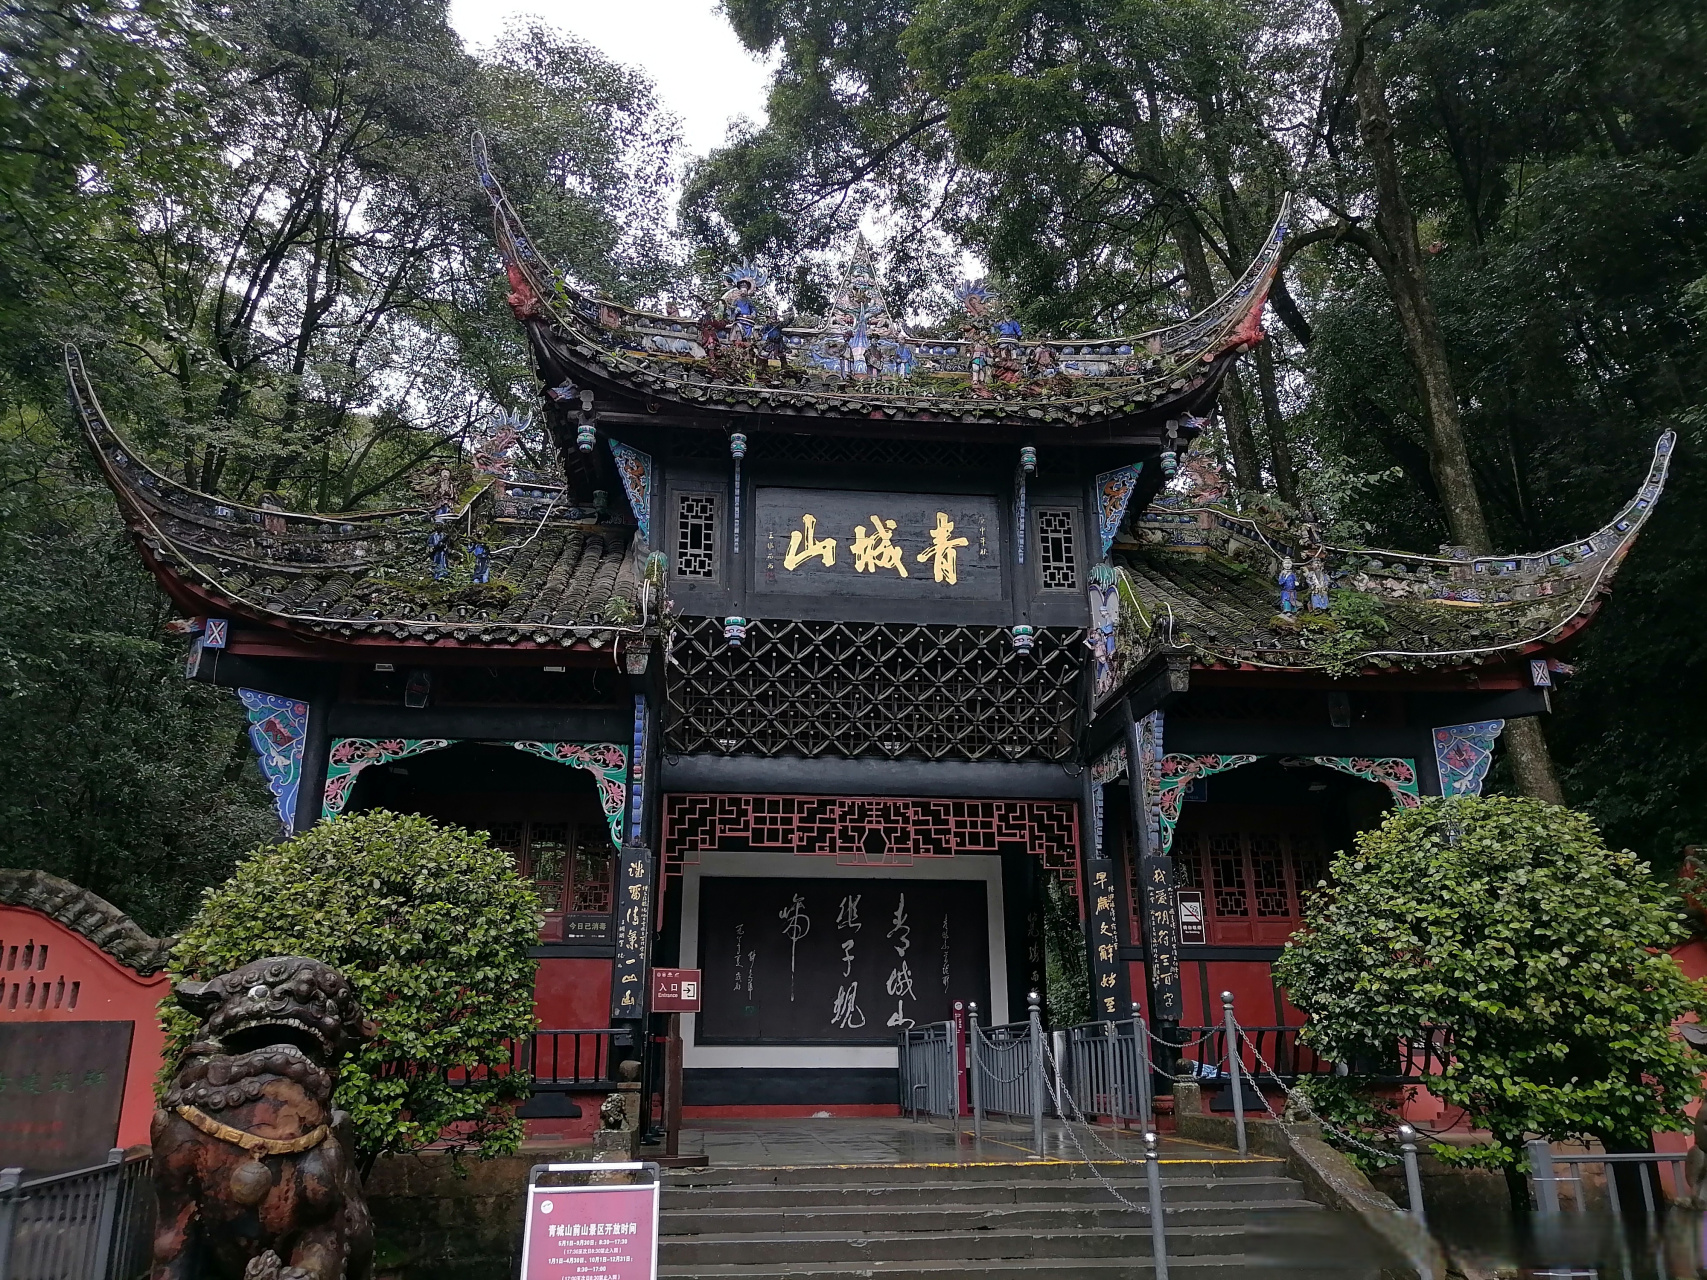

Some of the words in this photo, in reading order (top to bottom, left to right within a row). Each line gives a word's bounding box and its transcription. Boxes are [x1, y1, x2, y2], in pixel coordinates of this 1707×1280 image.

[783, 511, 969, 585] 青城山
[886, 892, 917, 1029] 青城山
[658, 982, 678, 992] 入口
[548, 1222, 637, 1237] 青城山前山景区开放时间
